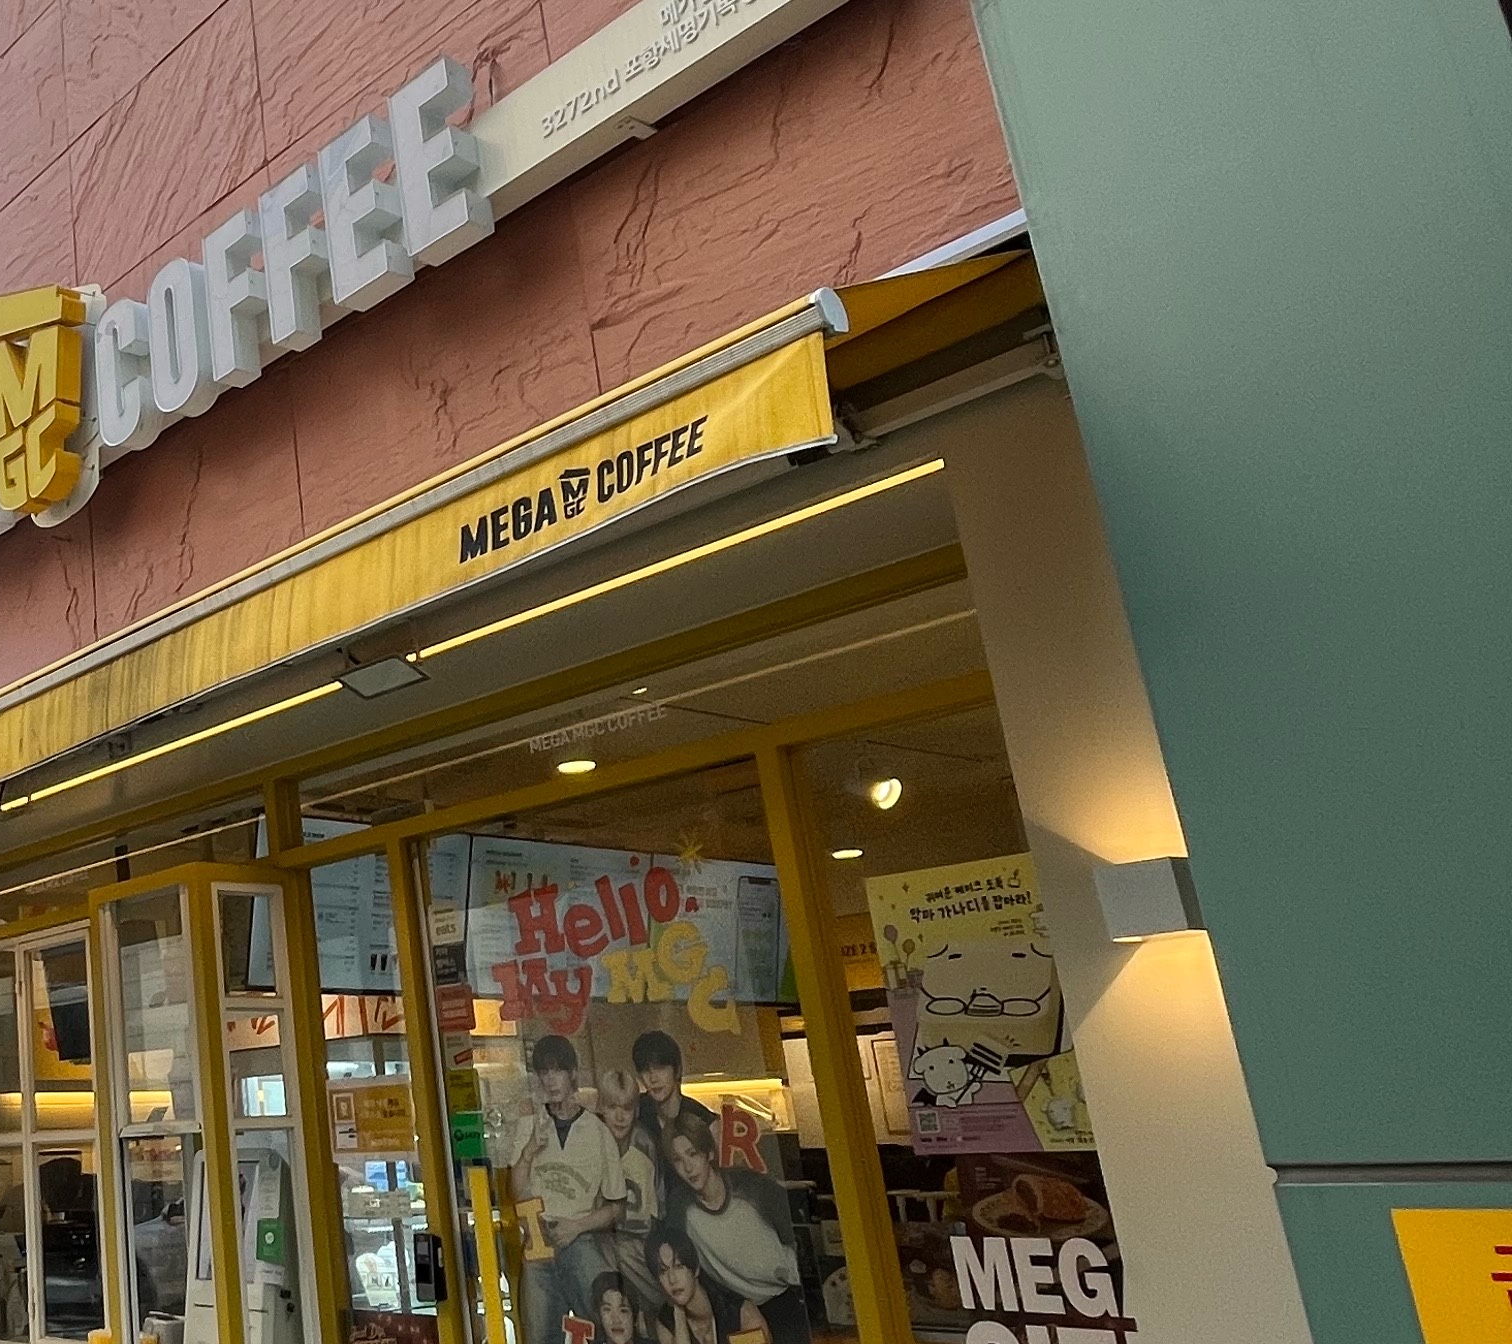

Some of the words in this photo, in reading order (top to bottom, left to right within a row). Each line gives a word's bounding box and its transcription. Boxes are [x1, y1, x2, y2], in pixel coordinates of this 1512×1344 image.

[541, 68, 621, 139] 3272nd
[94, 58, 491, 451] COFFEE
[458, 487, 558, 564] MEGA
[597, 415, 708, 504] COFFEE
[528, 730, 571, 754] MEGA
[572, 720, 606, 742] MGC
[607, 706, 668, 733] COFFEE
[949, 1235, 1128, 1319] MEG
